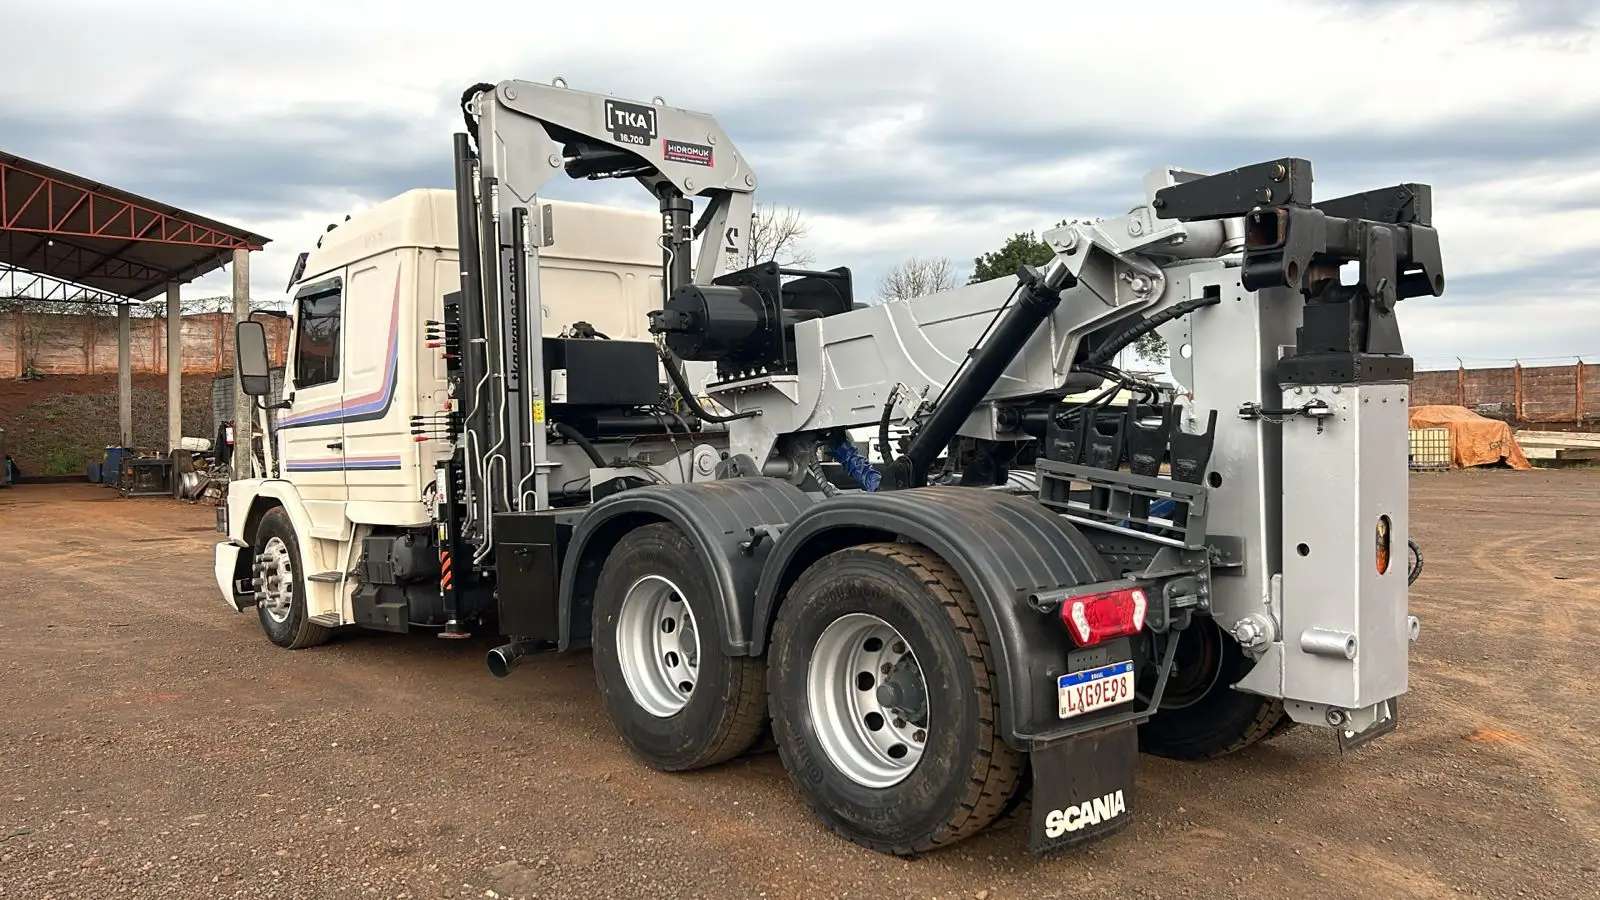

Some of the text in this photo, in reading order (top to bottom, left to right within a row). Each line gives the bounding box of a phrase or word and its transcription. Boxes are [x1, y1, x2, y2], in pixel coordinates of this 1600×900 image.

[668, 144, 709, 157] HIDROMUK
[508, 257, 519, 380] tkacranescom
[1067, 676, 1127, 712] LXG9E98
[1045, 789, 1126, 839] SCANIA
